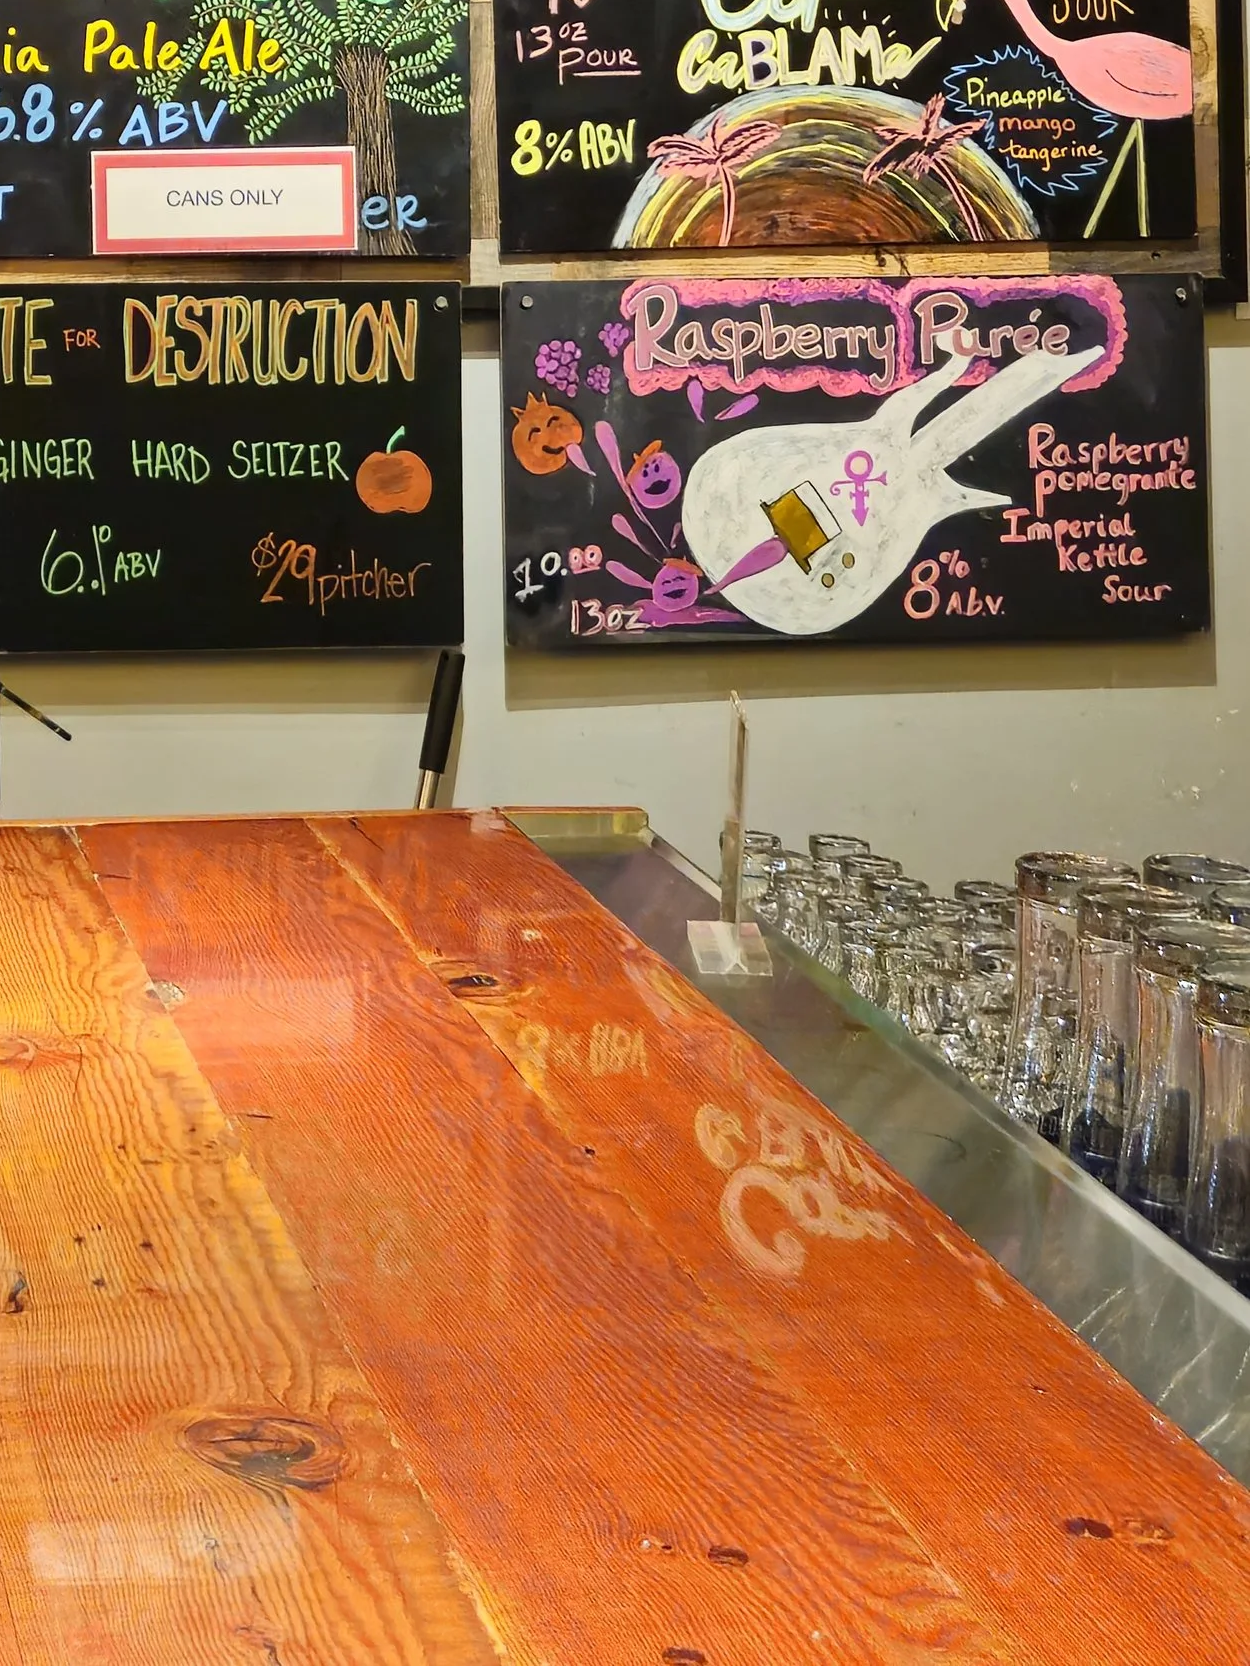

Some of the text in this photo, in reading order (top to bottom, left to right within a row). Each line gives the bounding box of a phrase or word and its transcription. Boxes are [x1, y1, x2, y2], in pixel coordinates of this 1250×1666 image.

[84, 18, 180, 73] Pale
[199, 19, 286, 77] Ale
[966, 77, 1067, 109] Pineapple
[119, 99, 228, 146] ABV
[578, 118, 636, 170] ABV
[999, 117, 1076, 139] mango
[998, 140, 1103, 172] tangerine
[166, 186, 284, 208] CANS ONLY
[64, 328, 101, 352] FOR
[123, 294, 418, 387] DESTRUCTION
[628, 285, 895, 391] Raspberry
[131, 437, 210, 485] HARD
[1029, 422, 1190, 473] Raspberry
[1000, 508, 1136, 547] Imperial
[114, 549, 161, 583] ABV
[251, 532, 316, 607] $29
[317, 559, 432, 619] pitcher
[1060, 543, 1147, 573] Kettle
[1102, 574, 1172, 605] Sour
